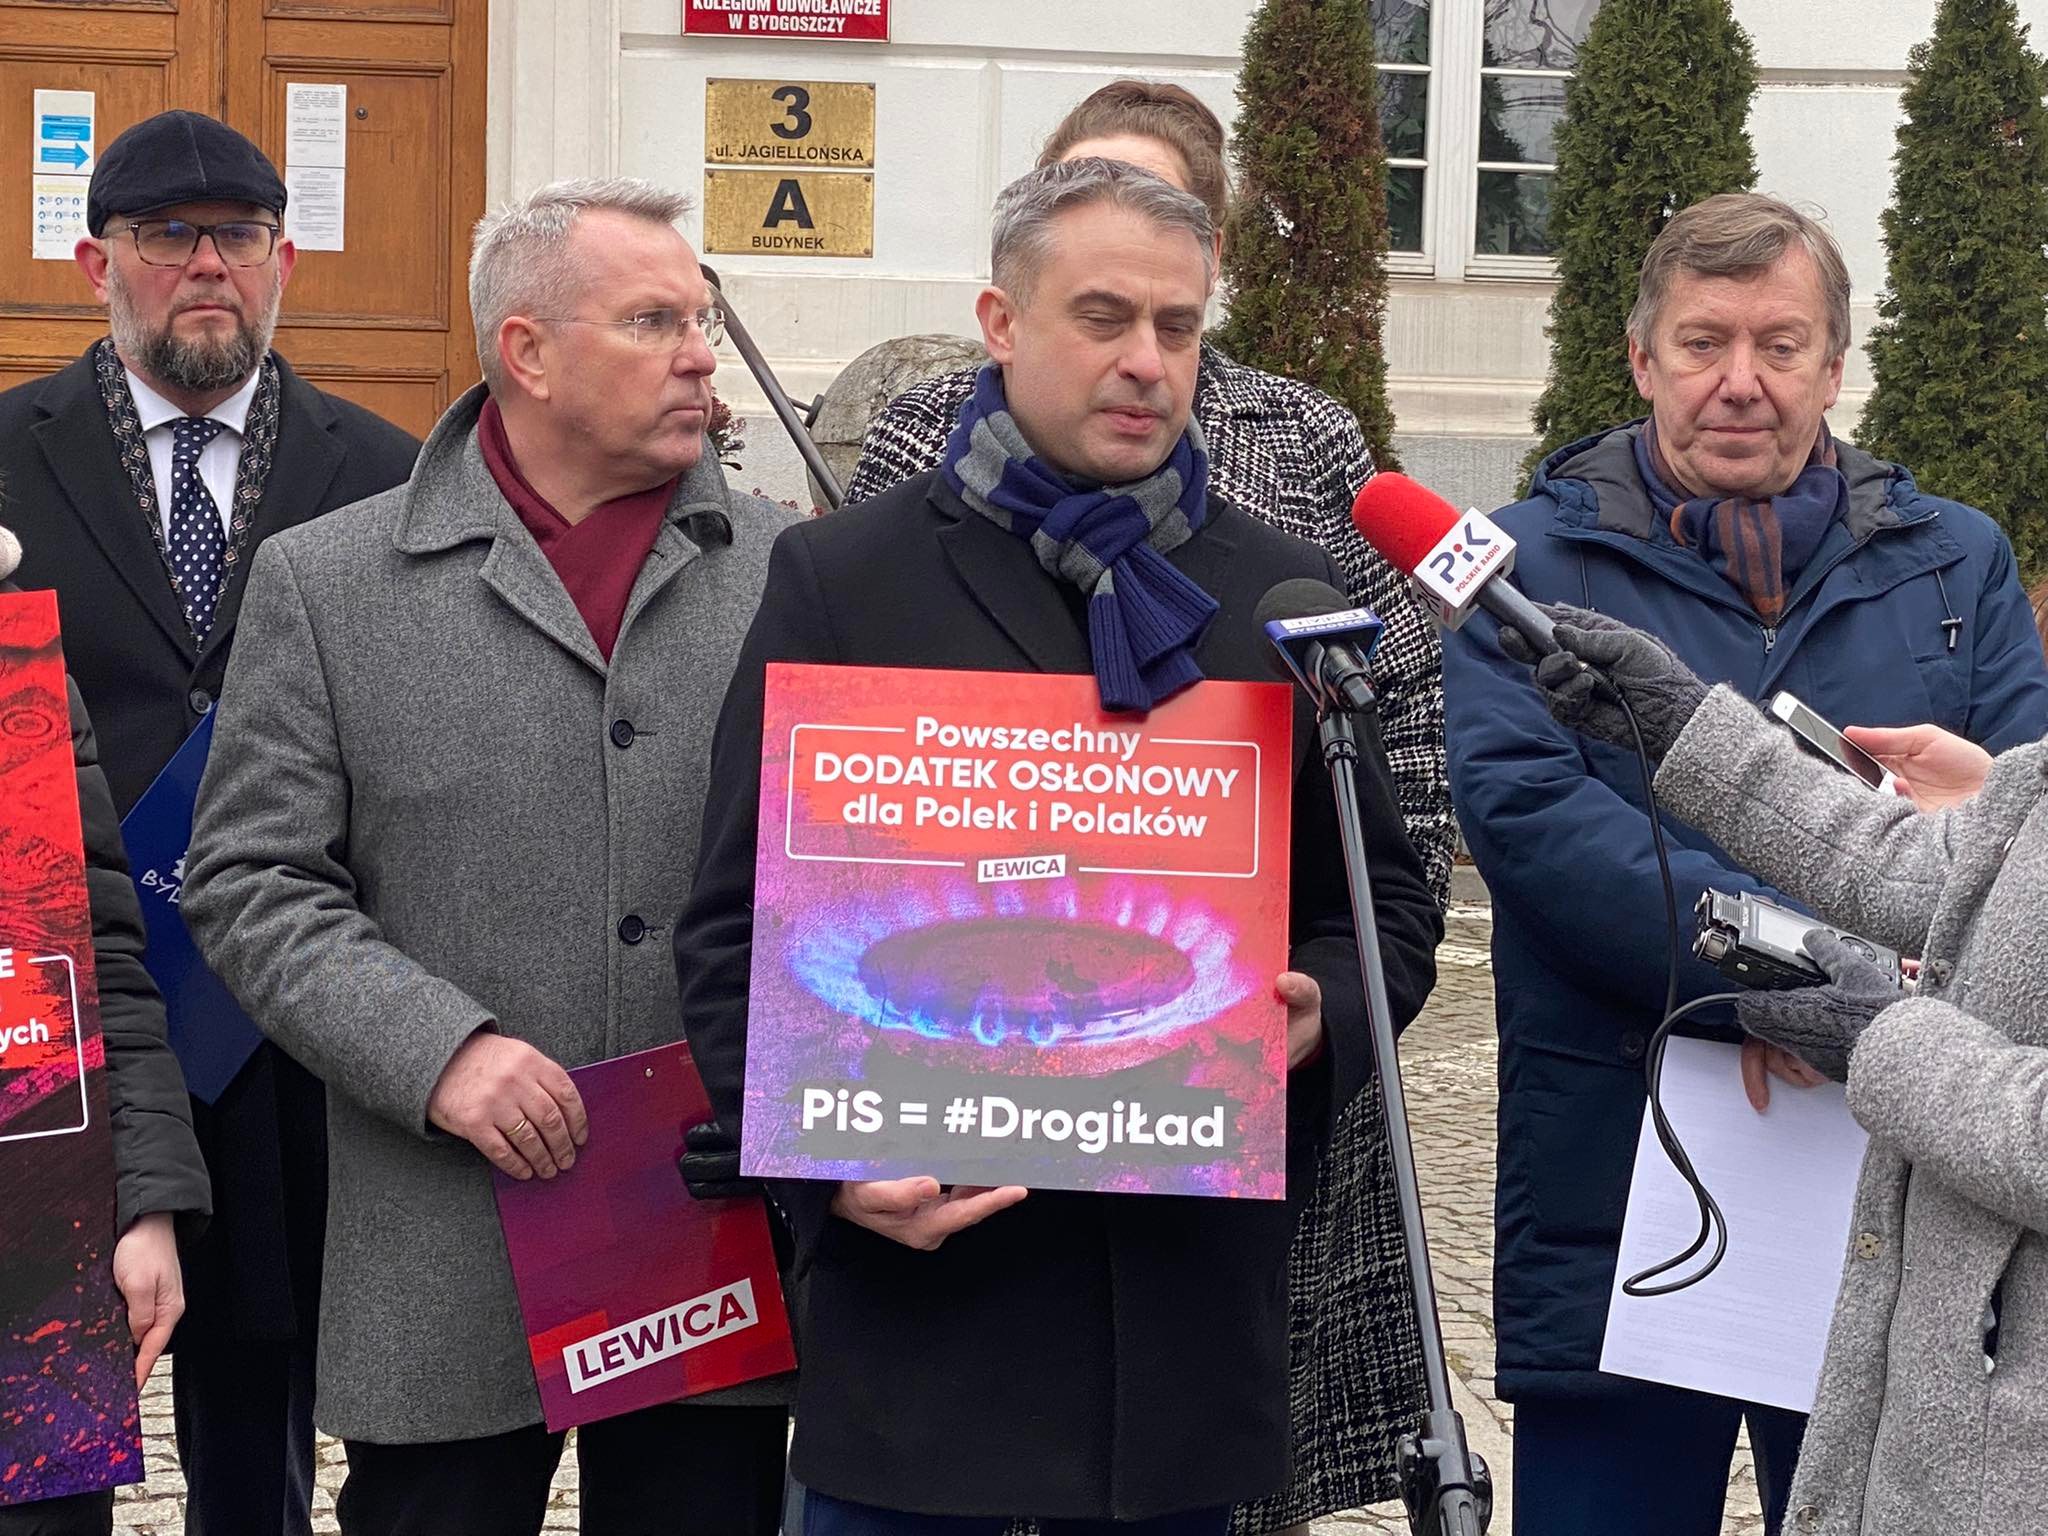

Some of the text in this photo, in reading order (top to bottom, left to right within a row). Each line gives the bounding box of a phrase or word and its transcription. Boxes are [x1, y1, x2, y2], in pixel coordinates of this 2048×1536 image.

[728, 13, 846, 33] W BYDGOSZCZY
[770, 86, 812, 139] 3
[715, 145, 864, 161] ul. JAGIELLOŃSKA
[762, 179, 815, 229] A
[752, 236, 825, 249] BUDYNEK
[1455, 544, 1501, 593] POLSKIE RADIO
[915, 715, 1141, 761] Powszechny
[815, 752, 1239, 798] DODATEK OSŁONOWY
[842, 793, 1207, 837] dla Polek i Polaków
[983, 859, 1061, 878] LEWICA
[802, 1088, 883, 1133] PiS
[943, 1096, 1225, 1154] #DrogiŁad
[577, 1292, 748, 1381] LEWICA
